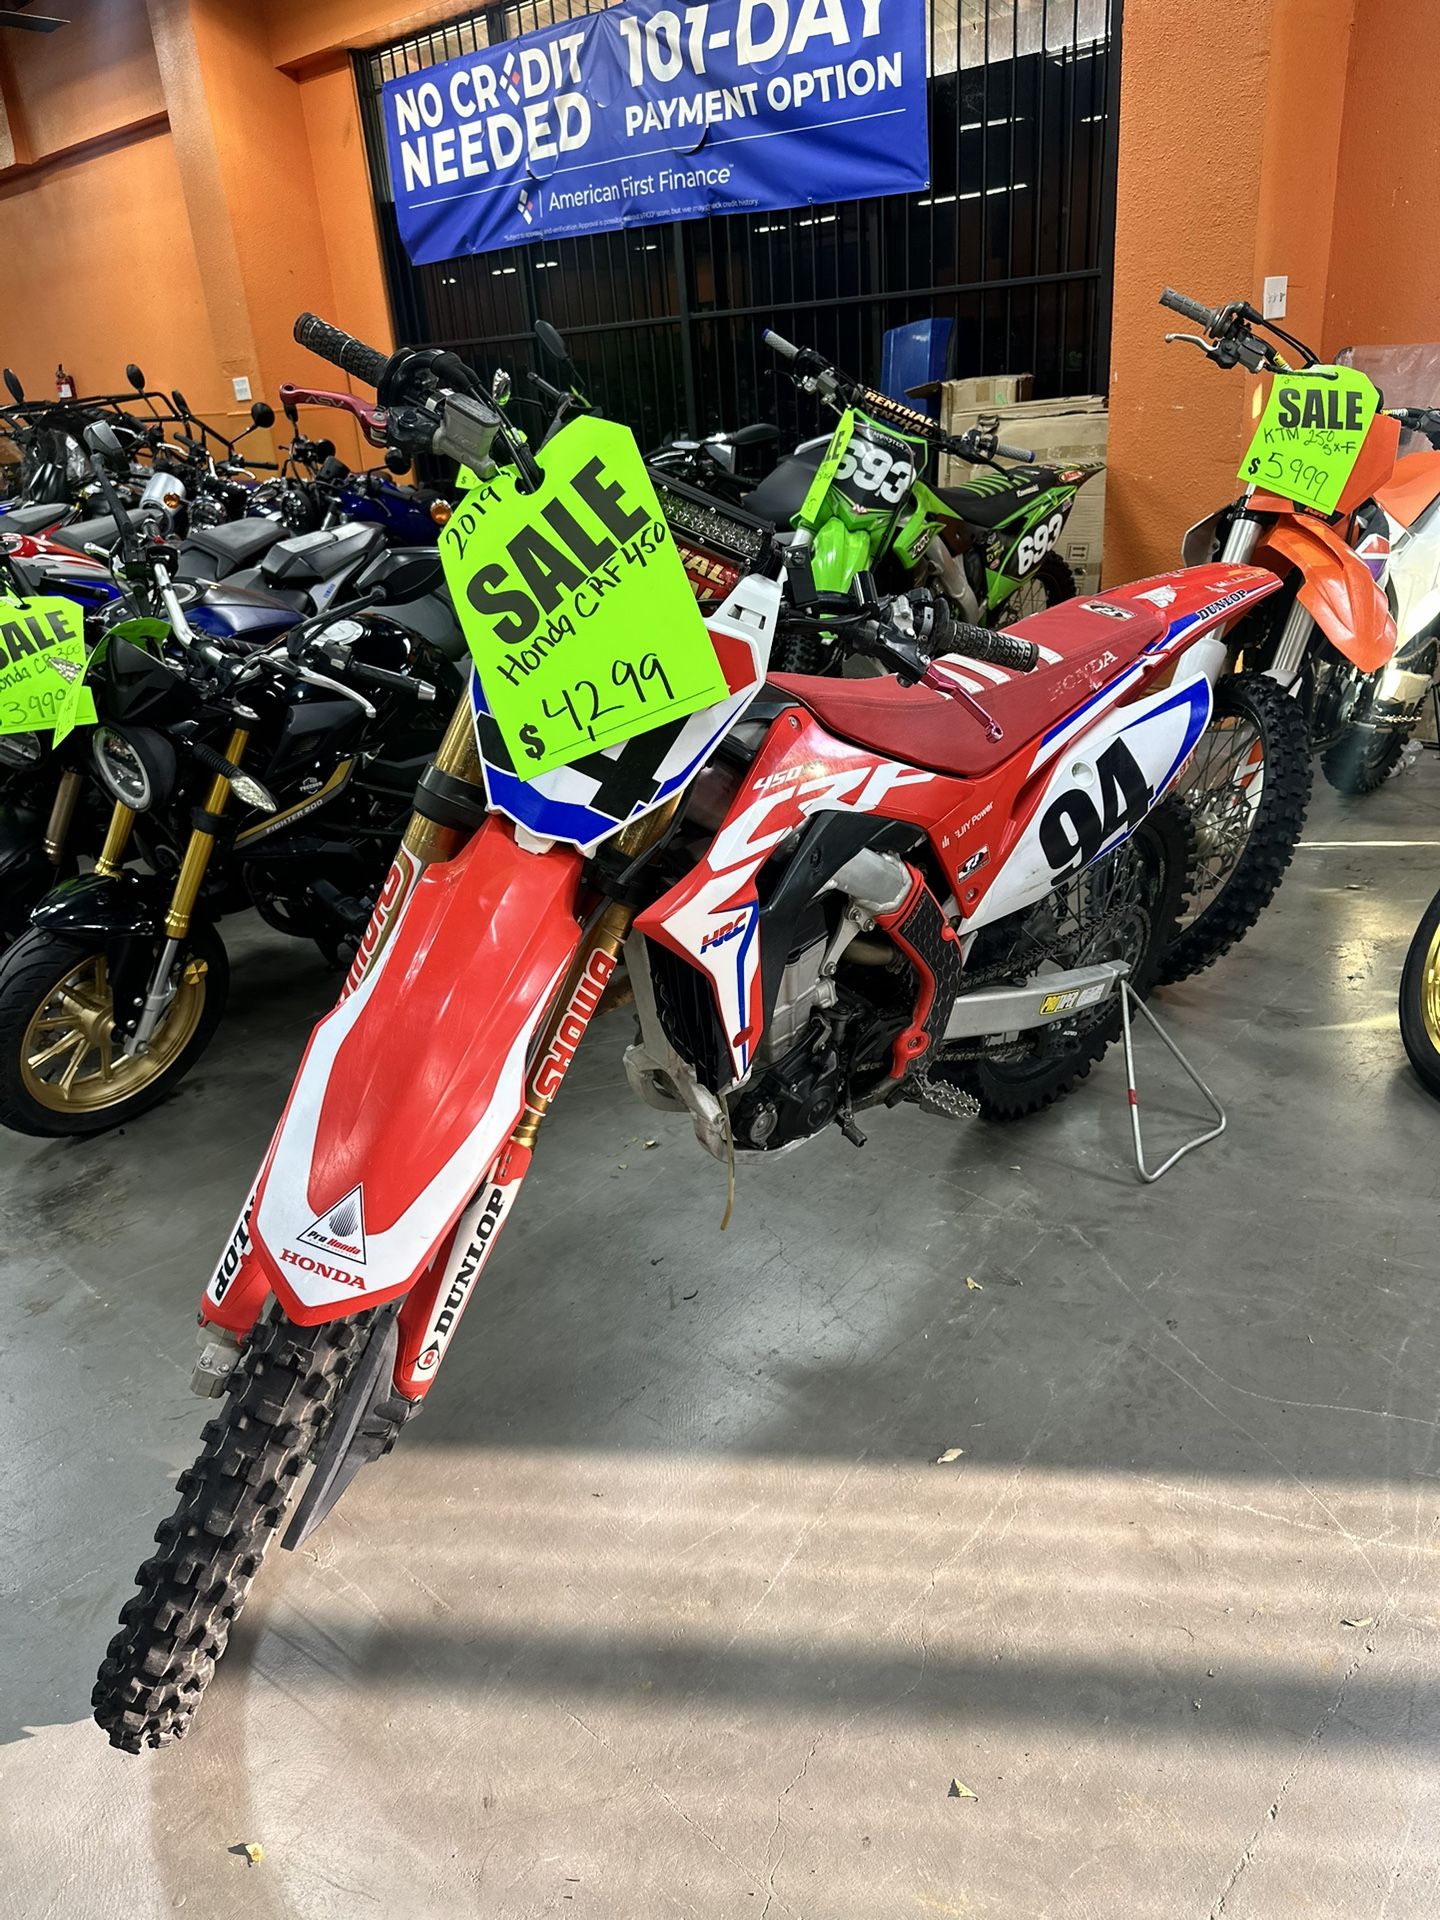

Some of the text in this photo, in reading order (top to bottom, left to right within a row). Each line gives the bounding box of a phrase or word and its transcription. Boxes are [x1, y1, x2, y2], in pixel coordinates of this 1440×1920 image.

[394, 82, 444, 136] NO
[625, 51, 903, 137] PAYMENT OPTION
[400, 92, 592, 192] NEEDED
[549, 184, 621, 212] American
[621, 175, 656, 199] First
[864, 391, 934, 427] RENTHAL
[1278, 387, 1363, 431] SALE
[1264, 427, 1300, 444] KTM
[1303, 429, 1335, 447] 250
[834, 438, 917, 504] 693
[1247, 452, 1329, 501] $ 5999
[446, 484, 503, 560] 2019
[1018, 513, 1063, 575] 693
[466, 455, 652, 645] SALE
[496, 521, 666, 687] Honda CRF 450
[1199, 588, 1247, 621] DUNLOP
[519, 723, 546, 761] $
[266, 799, 324, 834] FIGHTER 200
[971, 801, 994, 826] Power
[1039, 736, 1154, 887] 94
[701, 911, 747, 955] HRC
[532, 947, 618, 1103] SHOWA
[307, 1230, 328, 1243] Pro
[326, 1238, 362, 1255] Honda
[434, 1187, 503, 1337] DUNLOP
[279, 1248, 367, 1291] HONDA
